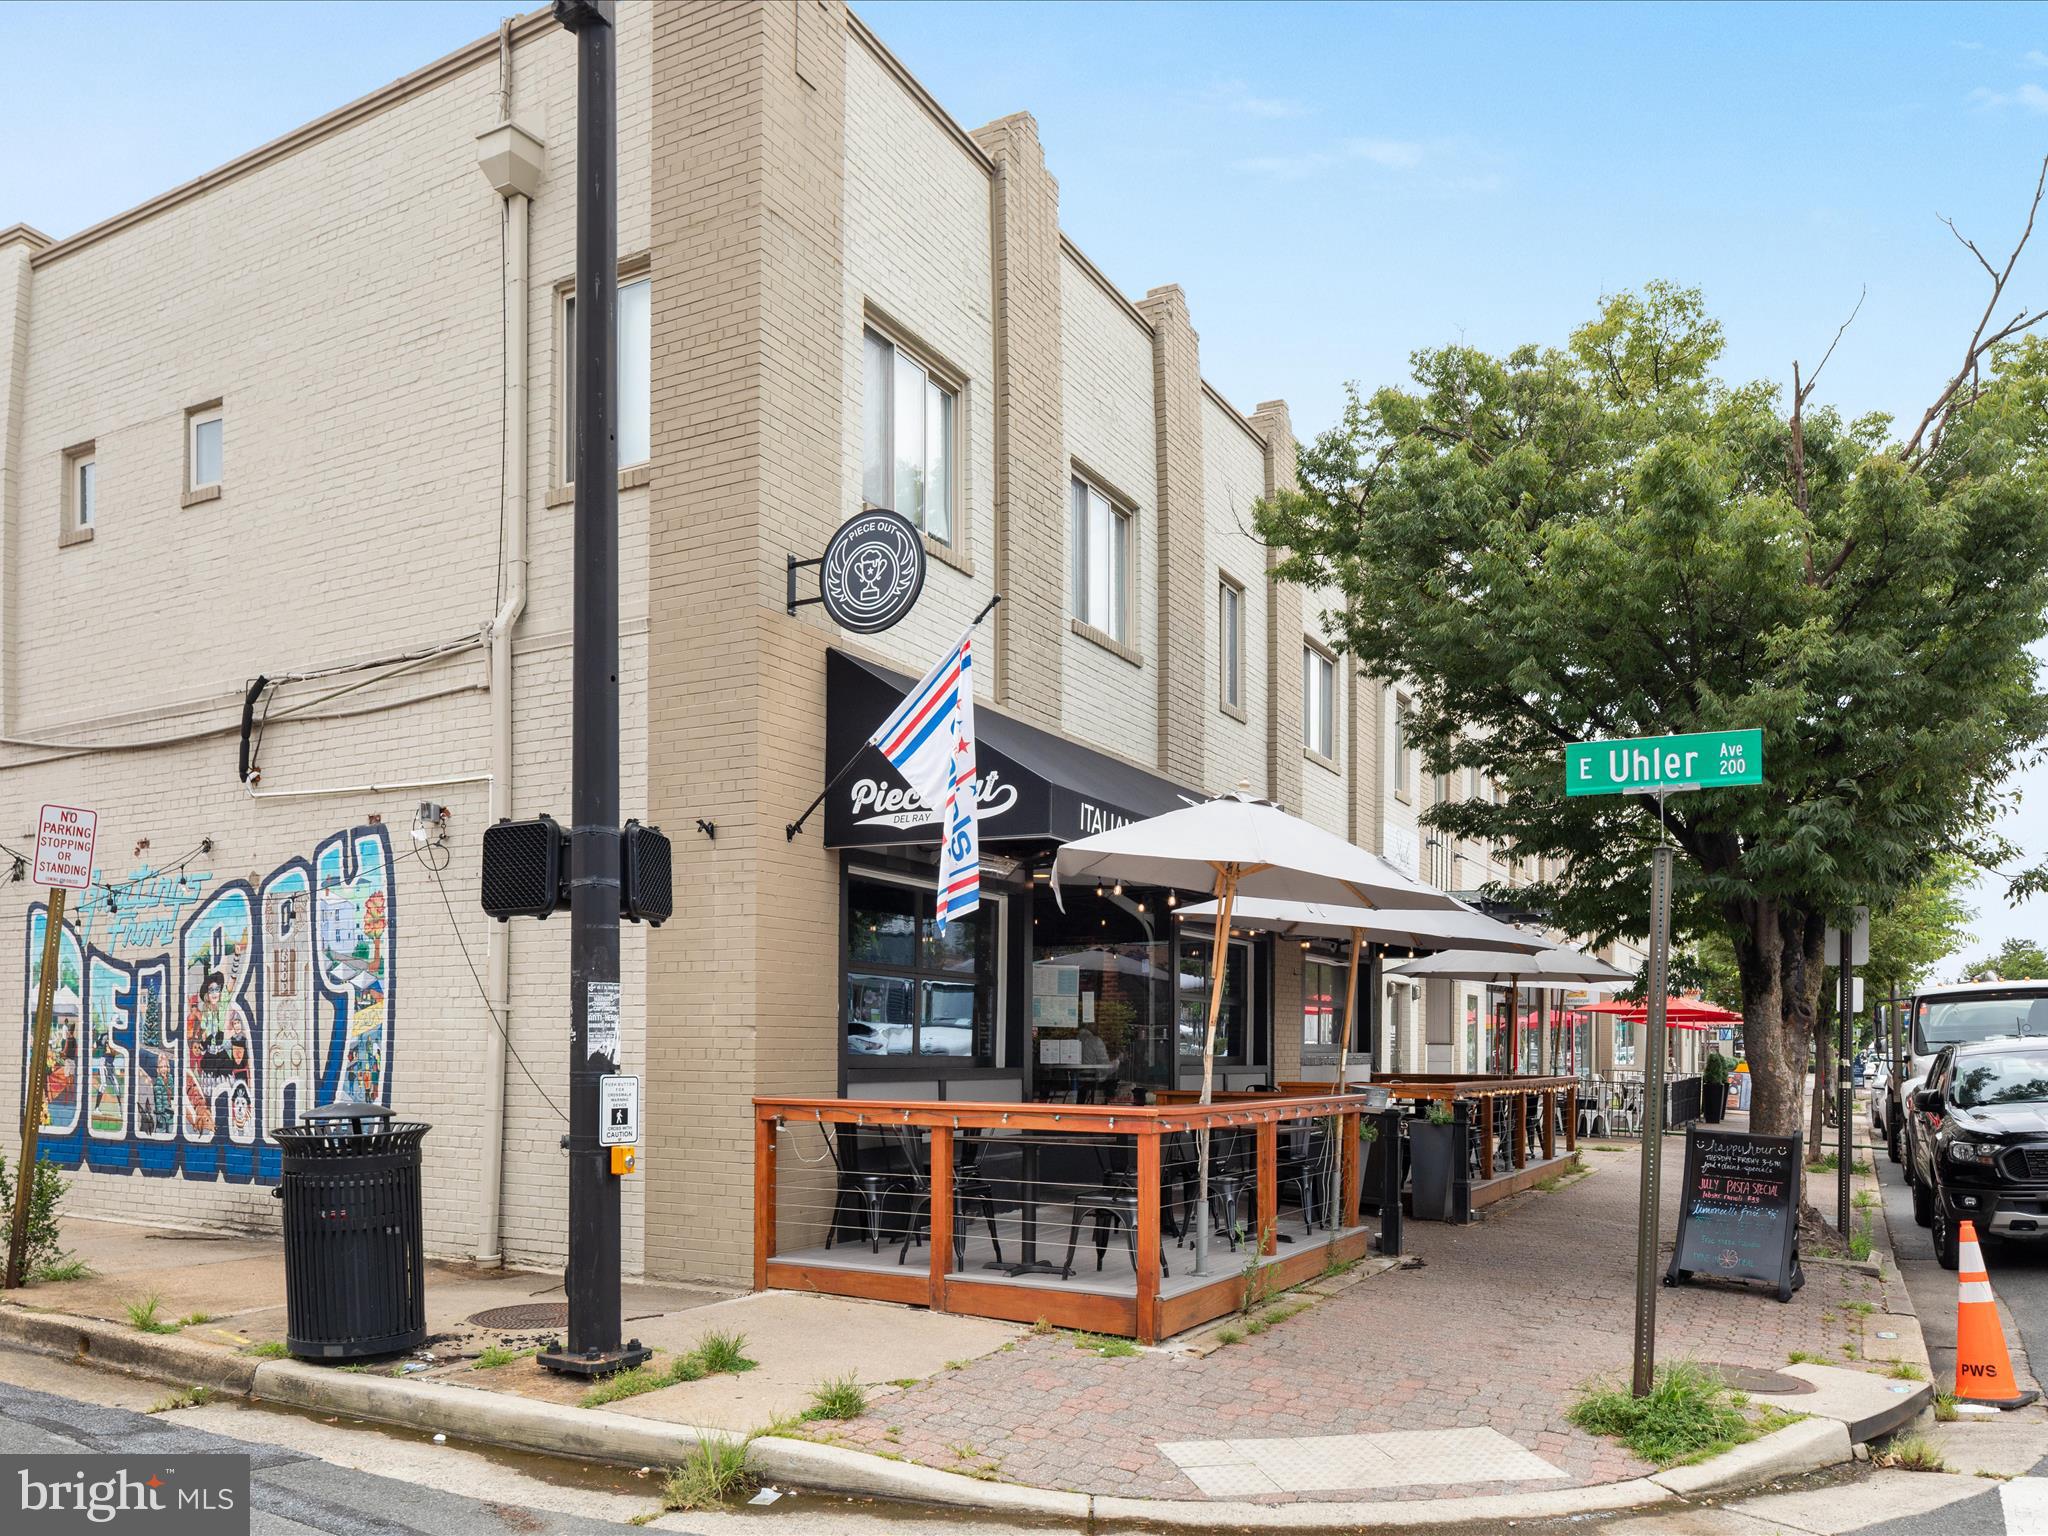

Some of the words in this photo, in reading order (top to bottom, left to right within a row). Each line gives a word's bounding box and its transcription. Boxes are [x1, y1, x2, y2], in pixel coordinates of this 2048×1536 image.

[848, 522, 876, 541] PIECE
[877, 522, 898, 534] OUT
[1579, 757, 1593, 780] E
[1609, 747, 1699, 783] Uhler
[1719, 742, 1743, 758] Ave
[1719, 759, 1746, 776] 200
[60, 811, 78, 823] NO
[893, 813, 910, 824] DEL
[911, 812, 932, 823] RAY
[43, 822, 92, 838] PARKING
[40, 836, 91, 852] STOPPING
[57, 851, 72, 861] OR
[39, 861, 87, 876] STANDING
[1698, 1178, 1719, 1190] JULY
[1726, 1179, 1750, 1194] PASTA
[1752, 1182, 1779, 1196] SPECIAL
[1961, 1363, 1998, 1377] PWS
